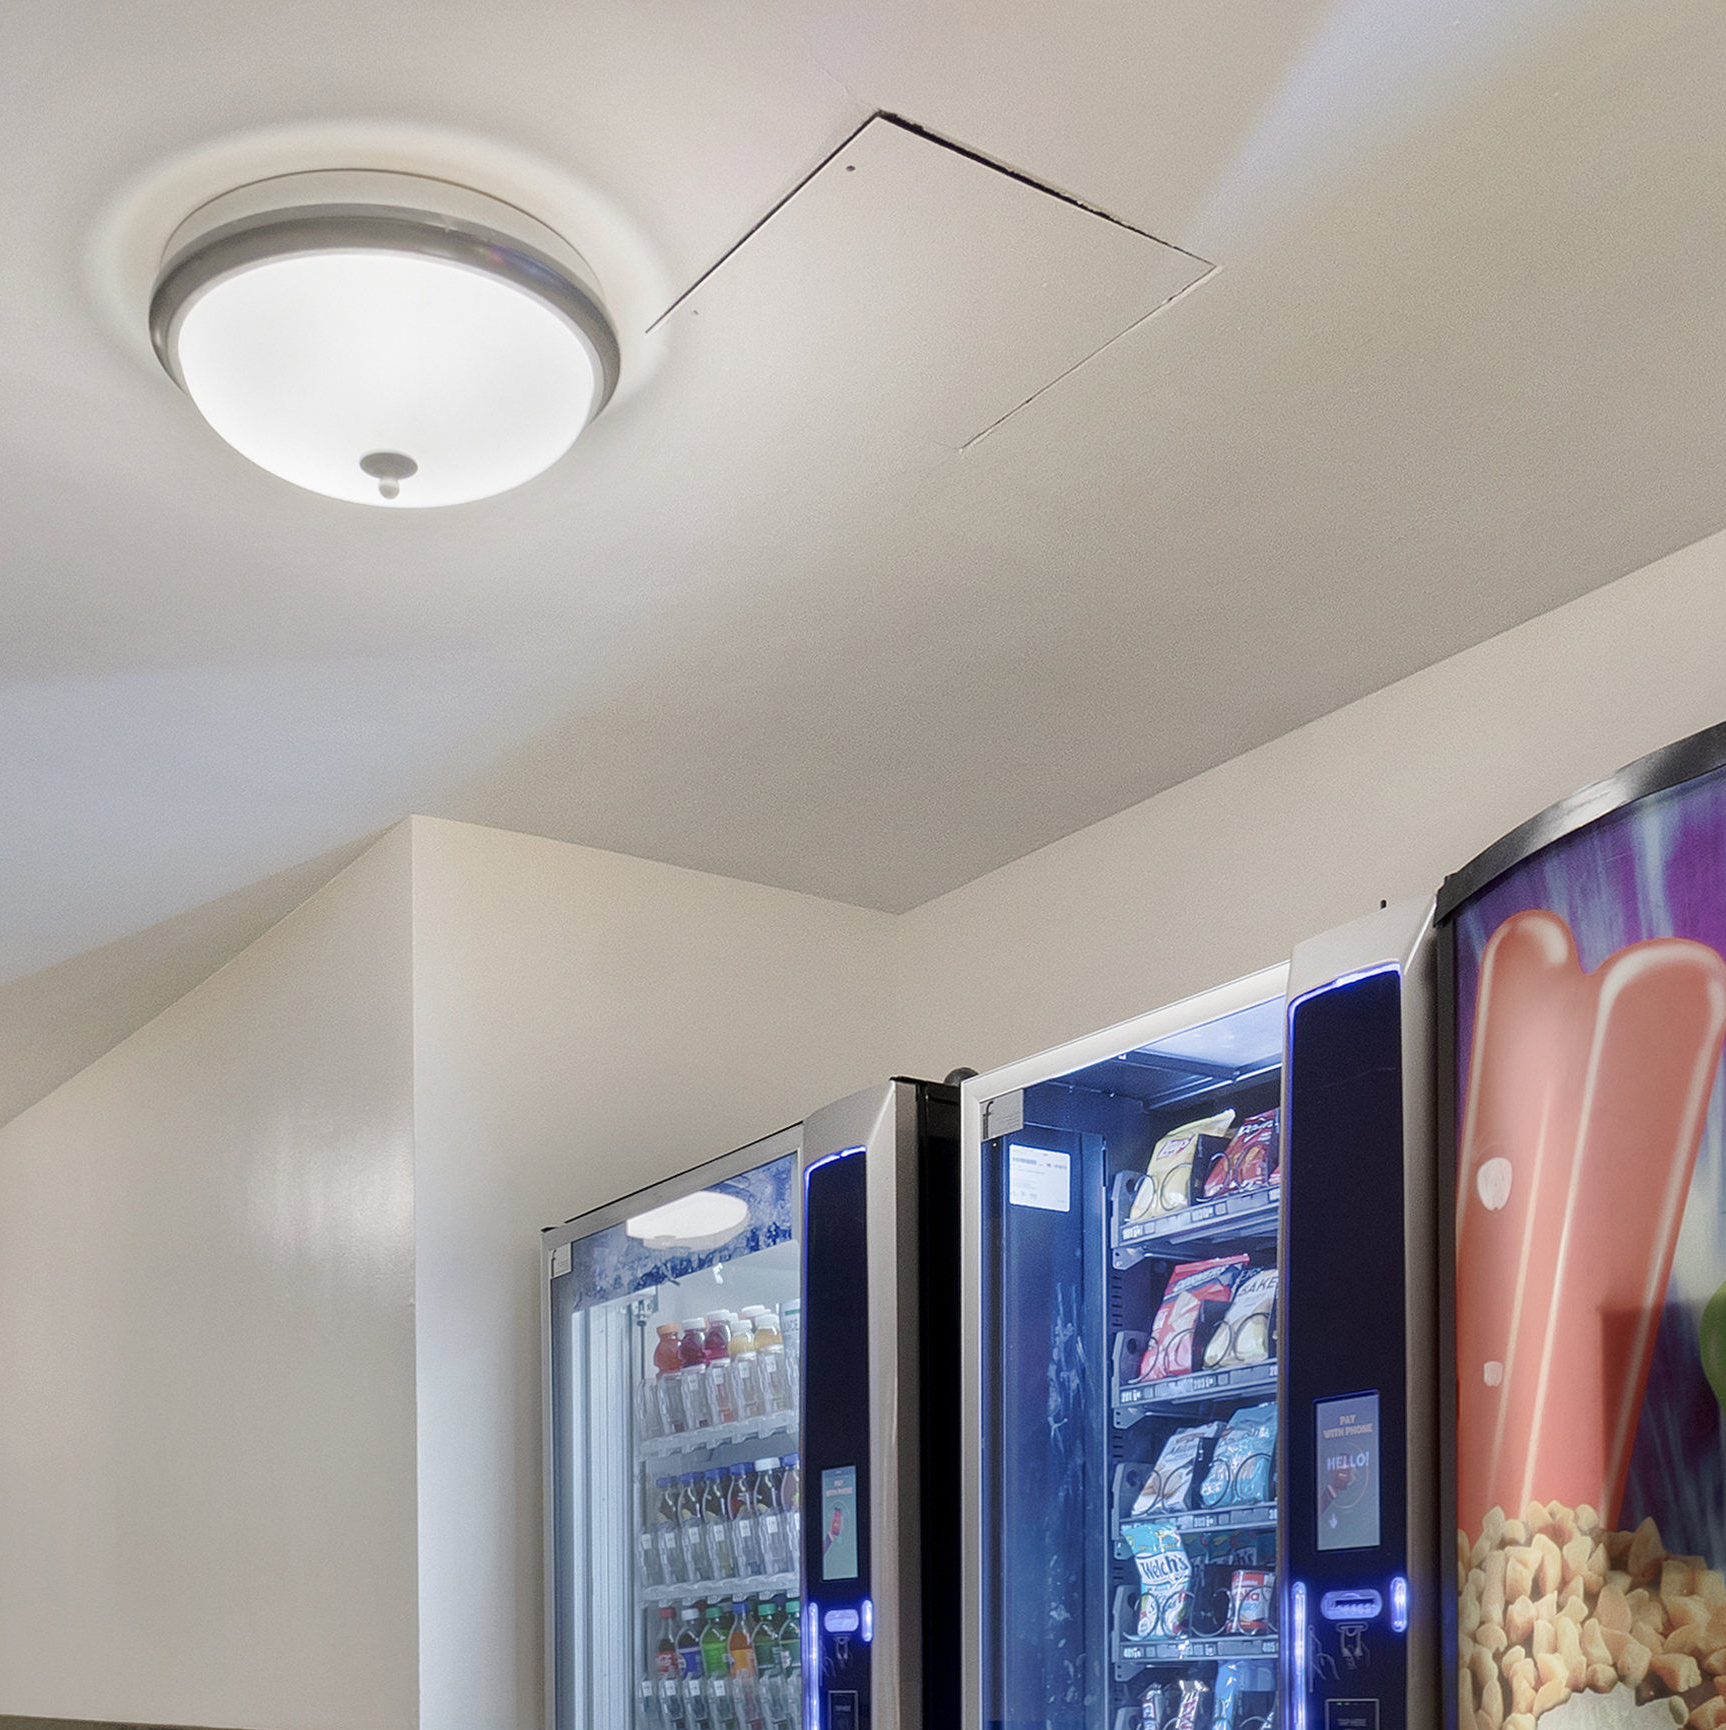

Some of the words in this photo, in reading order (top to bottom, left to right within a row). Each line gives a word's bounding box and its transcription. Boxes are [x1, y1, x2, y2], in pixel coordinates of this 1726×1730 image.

[1339, 1414, 1356, 1425] PAY
[1323, 1428, 1344, 1439] WITH
[1345, 1423, 1373, 1436] PHONE
[1327, 1451, 1370, 1471] HELLO!
[1140, 1555, 1189, 1581] Welch's
